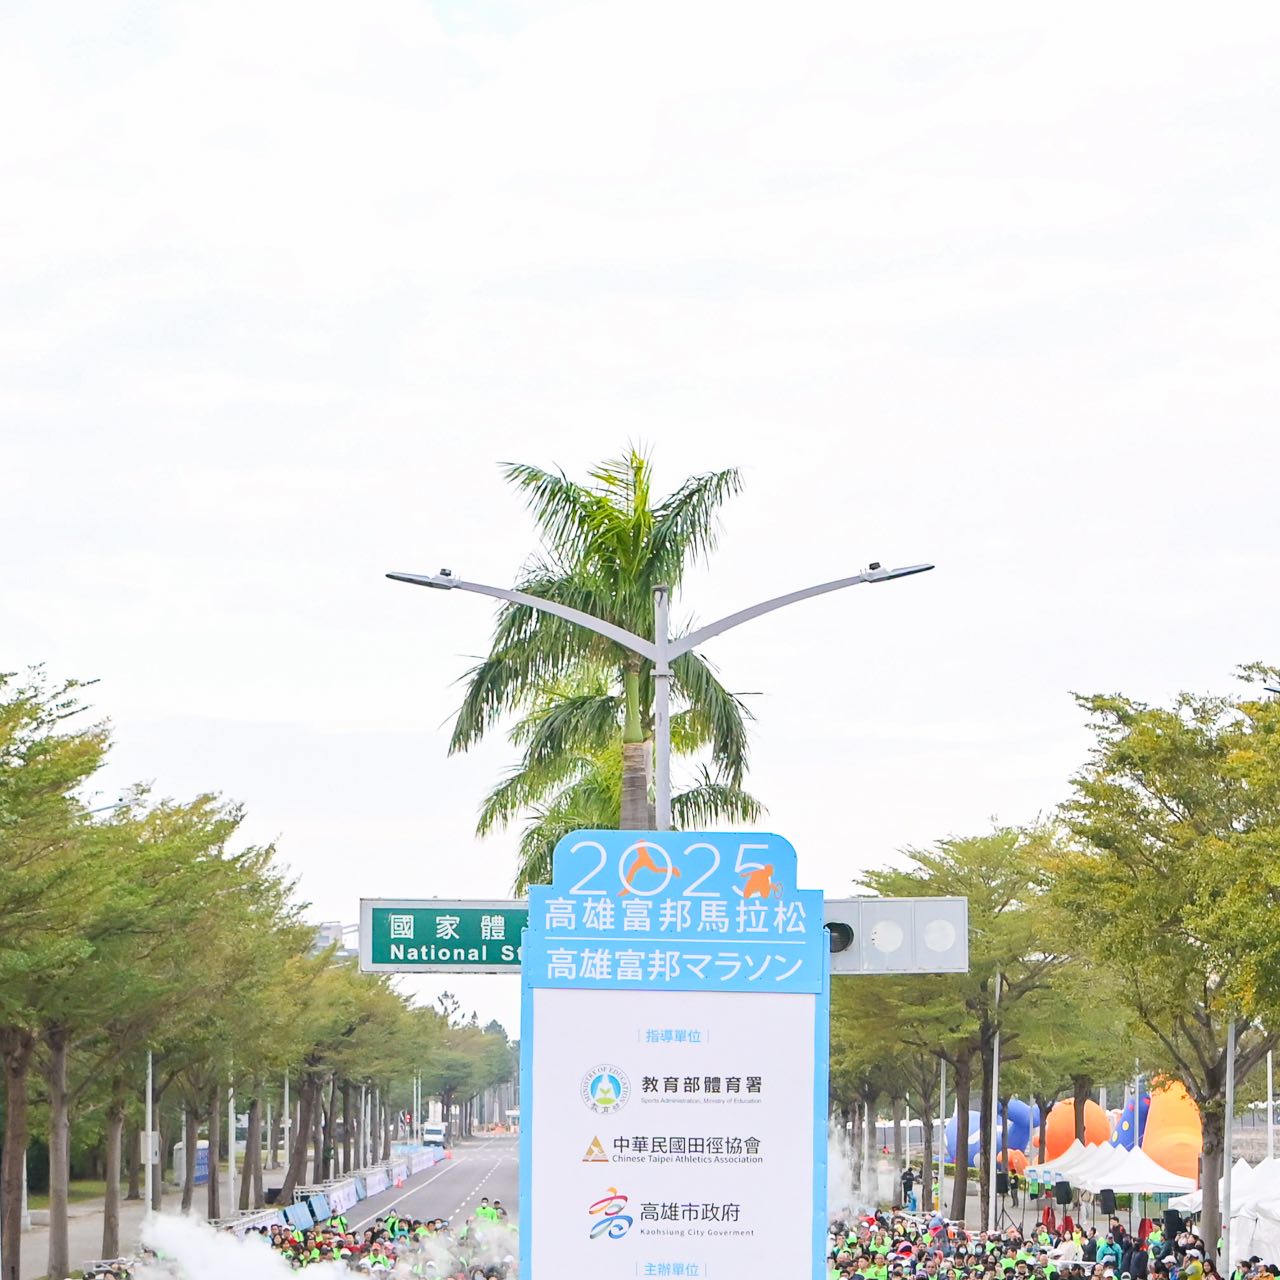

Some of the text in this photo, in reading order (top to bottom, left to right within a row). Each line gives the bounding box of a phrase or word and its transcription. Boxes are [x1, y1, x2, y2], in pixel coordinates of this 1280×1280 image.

[569, 841, 768, 898] 2025
[545, 896, 807, 933] 高雄富邦馬拉松
[391, 914, 528, 941] 國家體
[390, 944, 487, 961] National
[547, 947, 803, 982] 高雄富邦マラソン
[646, 1029, 701, 1044] 指導單位
[642, 1076, 762, 1094] 教育部體育署
[613, 1136, 761, 1154] 中華民國田徑協會
[612, 1155, 763, 1165] Chinese Taipei Athletics Association
[640, 1203, 740, 1222] 高雄市政府
[641, 1228, 685, 1237] Kaohsiung
[688, 1228, 705, 1237] City
[645, 1263, 699, 1277] 主辦單位
